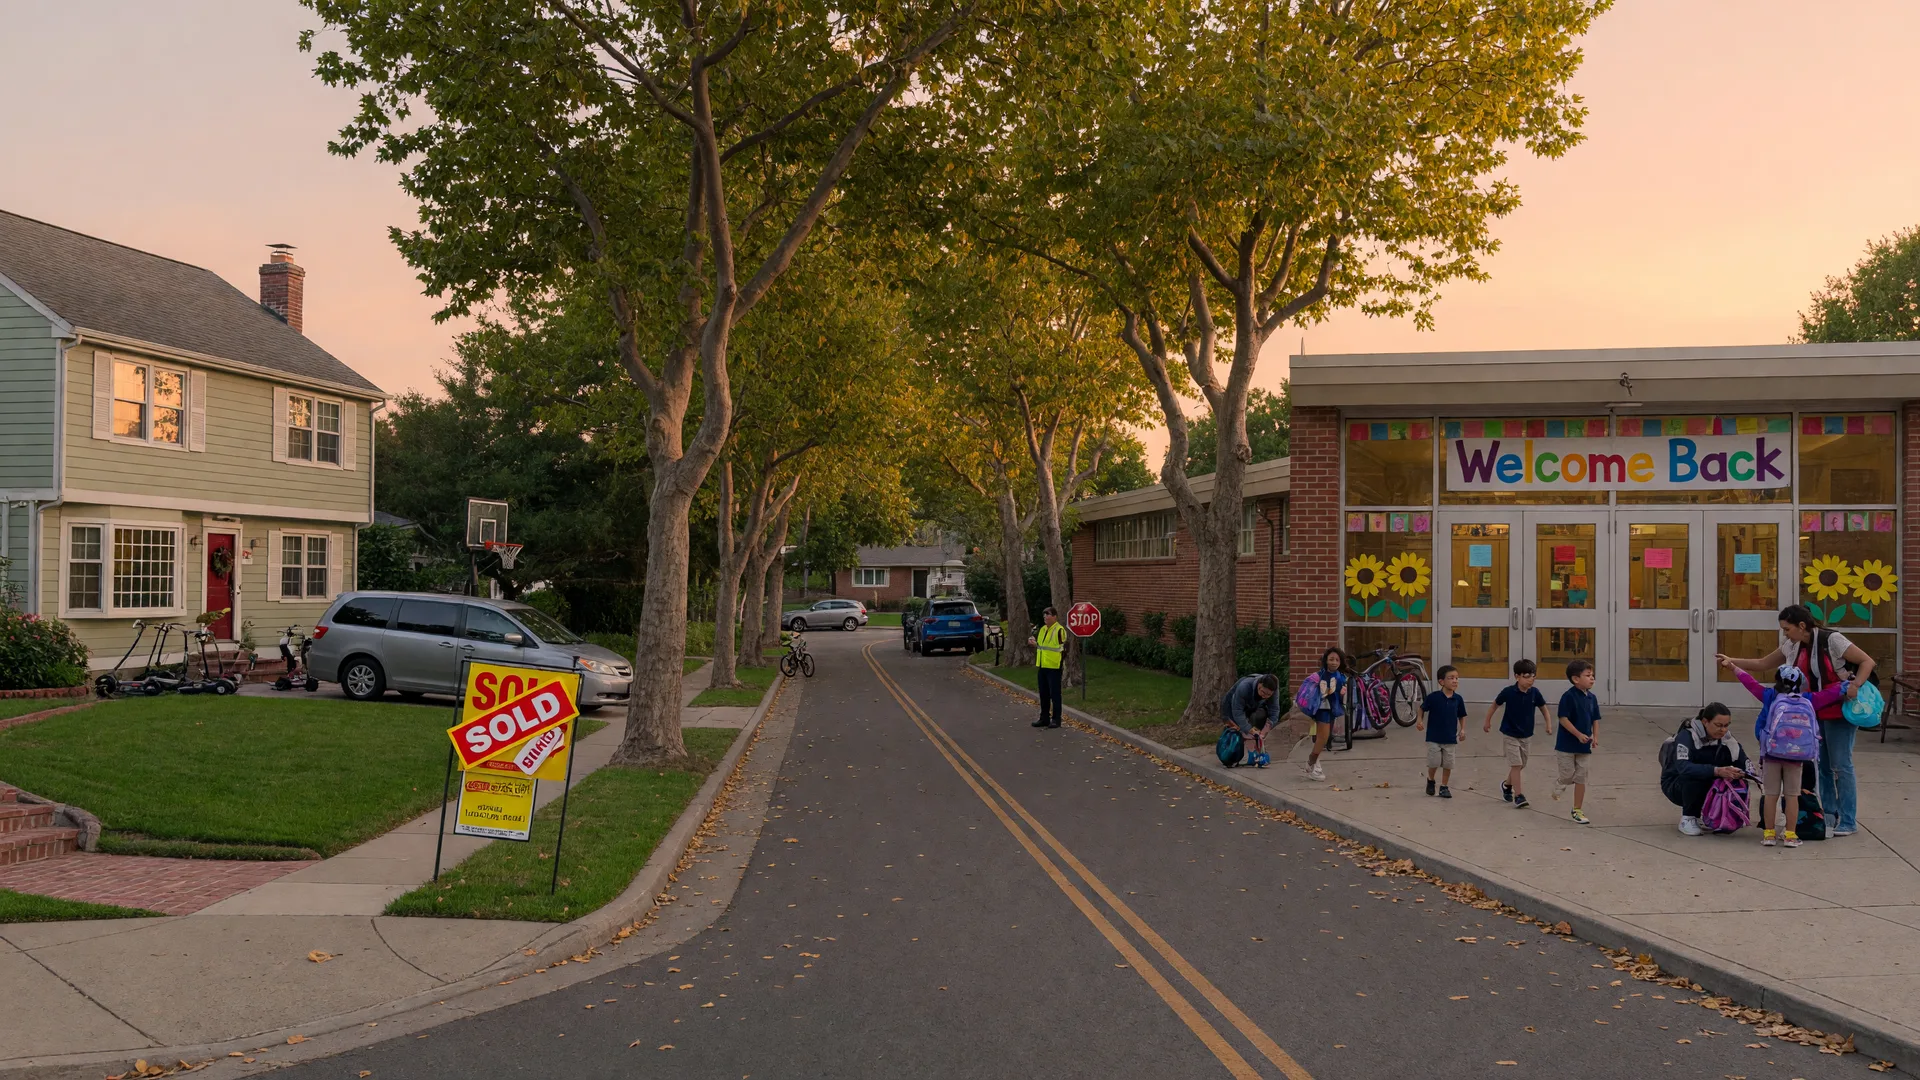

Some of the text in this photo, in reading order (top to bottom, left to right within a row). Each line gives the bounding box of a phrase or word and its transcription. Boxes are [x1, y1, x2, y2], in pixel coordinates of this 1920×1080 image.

[1456, 437, 1785, 483] Welcome Back
[1070, 613, 1098, 626] STOP
[472, 672, 538, 710] SO
[466, 693, 560, 753] SOLD
